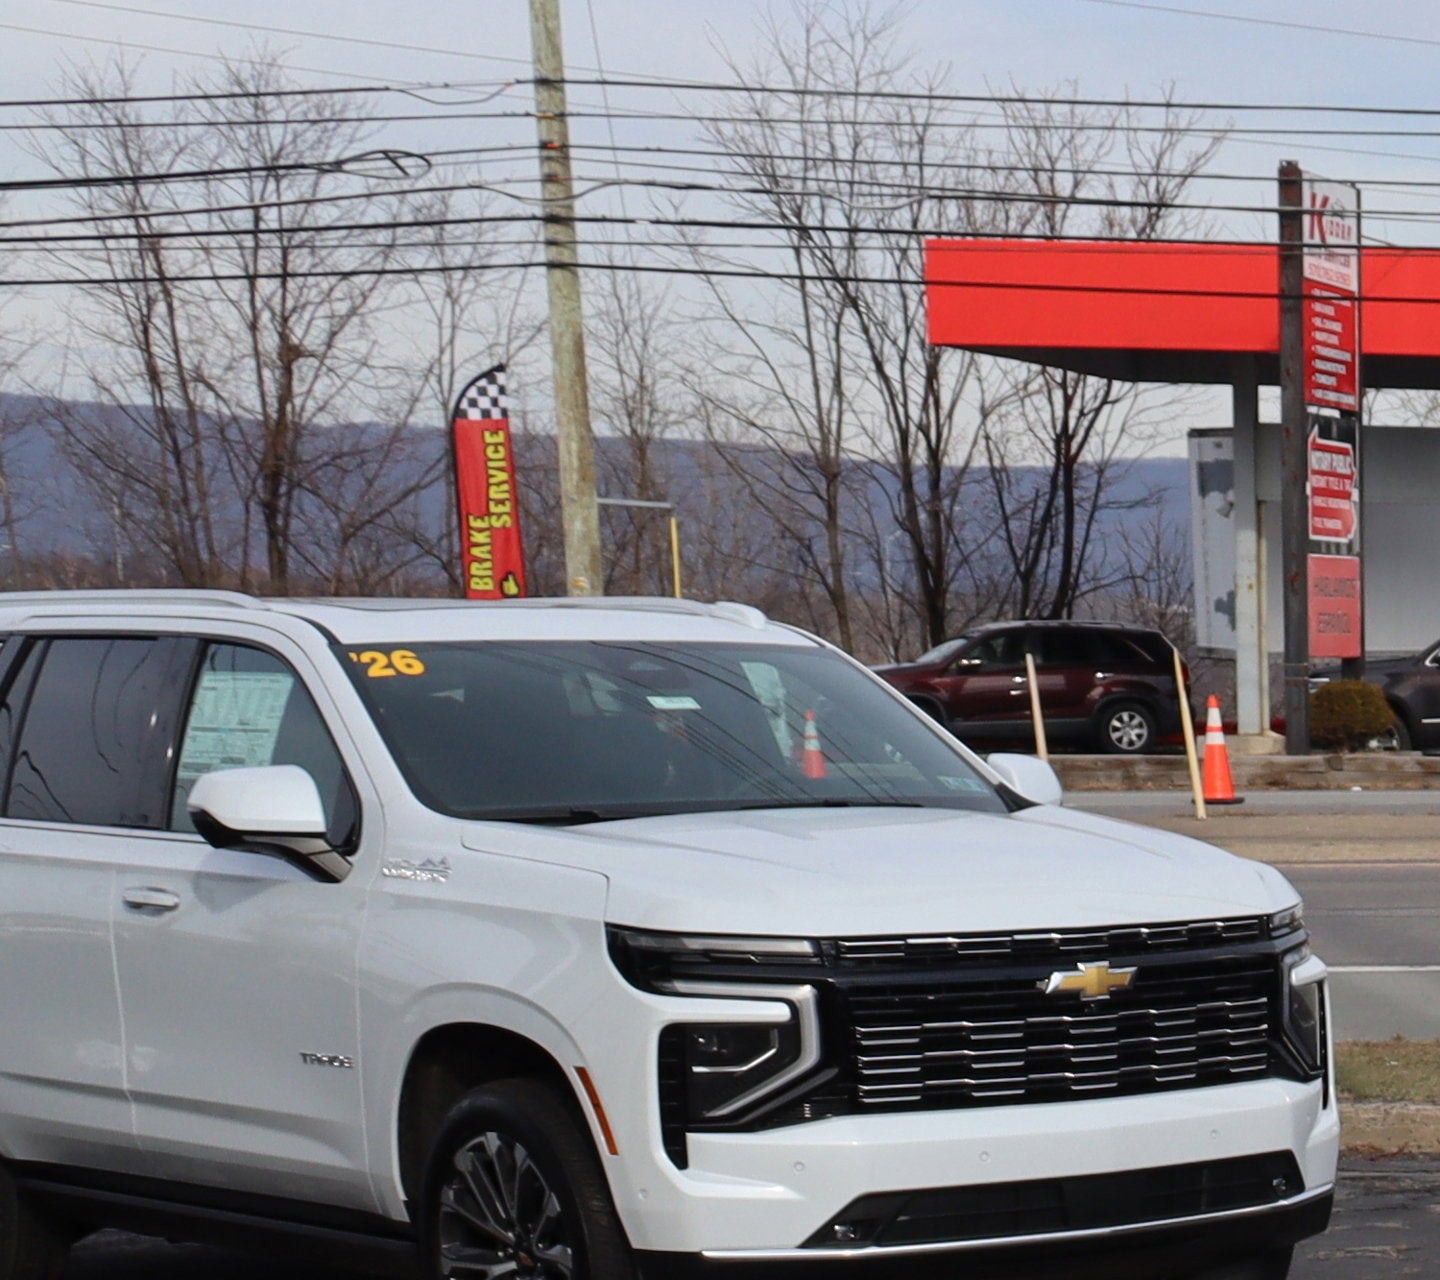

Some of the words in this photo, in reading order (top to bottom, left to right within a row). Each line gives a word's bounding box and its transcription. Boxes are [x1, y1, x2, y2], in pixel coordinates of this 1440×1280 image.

[483, 429, 513, 528] SERVICE
[468, 514, 495, 591] BRAKE
[348, 649, 425, 678] '26
